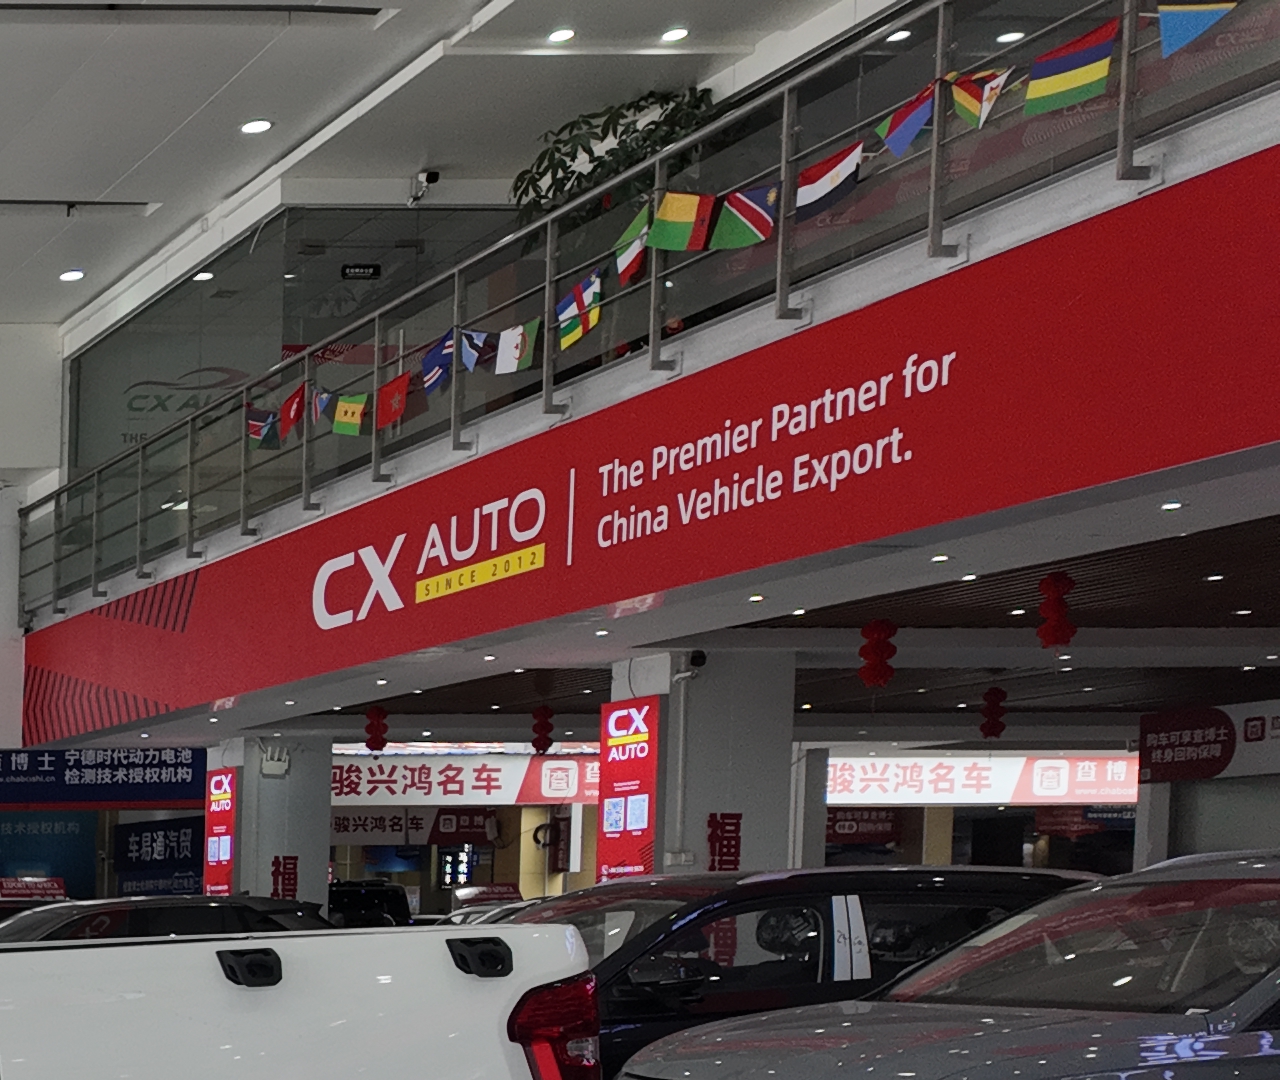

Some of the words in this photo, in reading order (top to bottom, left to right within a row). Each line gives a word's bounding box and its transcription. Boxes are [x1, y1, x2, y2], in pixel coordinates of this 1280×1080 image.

[597, 460, 644, 498] The
[652, 418, 762, 482] Premier
[770, 376, 893, 442] Partner
[903, 350, 956, 396] for
[597, 499, 669, 549] China
[676, 466, 784, 525] Vehicle
[792, 427, 913, 496] Export.
[311, 533, 407, 631] CX
[415, 487, 546, 575] AUTO
[424, 568, 478, 598] SINCE
[490, 551, 539, 580] 2012
[608, 705, 650, 737] CX
[1146, 725, 1229, 747] 购车可享查博士
[64, 748, 193, 767] 宁德时代动力电池
[608, 742, 649, 763] AUTO
[1151, 743, 1222, 763] 终身回购保障
[64, 767, 193, 786] 检测技术授权机构
[332, 762, 503, 797] 骏兴鸿名车
[827, 761, 993, 796] 骏兴鸿名车
[1075, 760, 1138, 783] 查博
[210, 773, 232, 795] CX
[210, 799, 232, 813] AUTO
[333, 815, 425, 833] 骏兴鸿名车
[127, 828, 192, 862] 车易通汽贸
